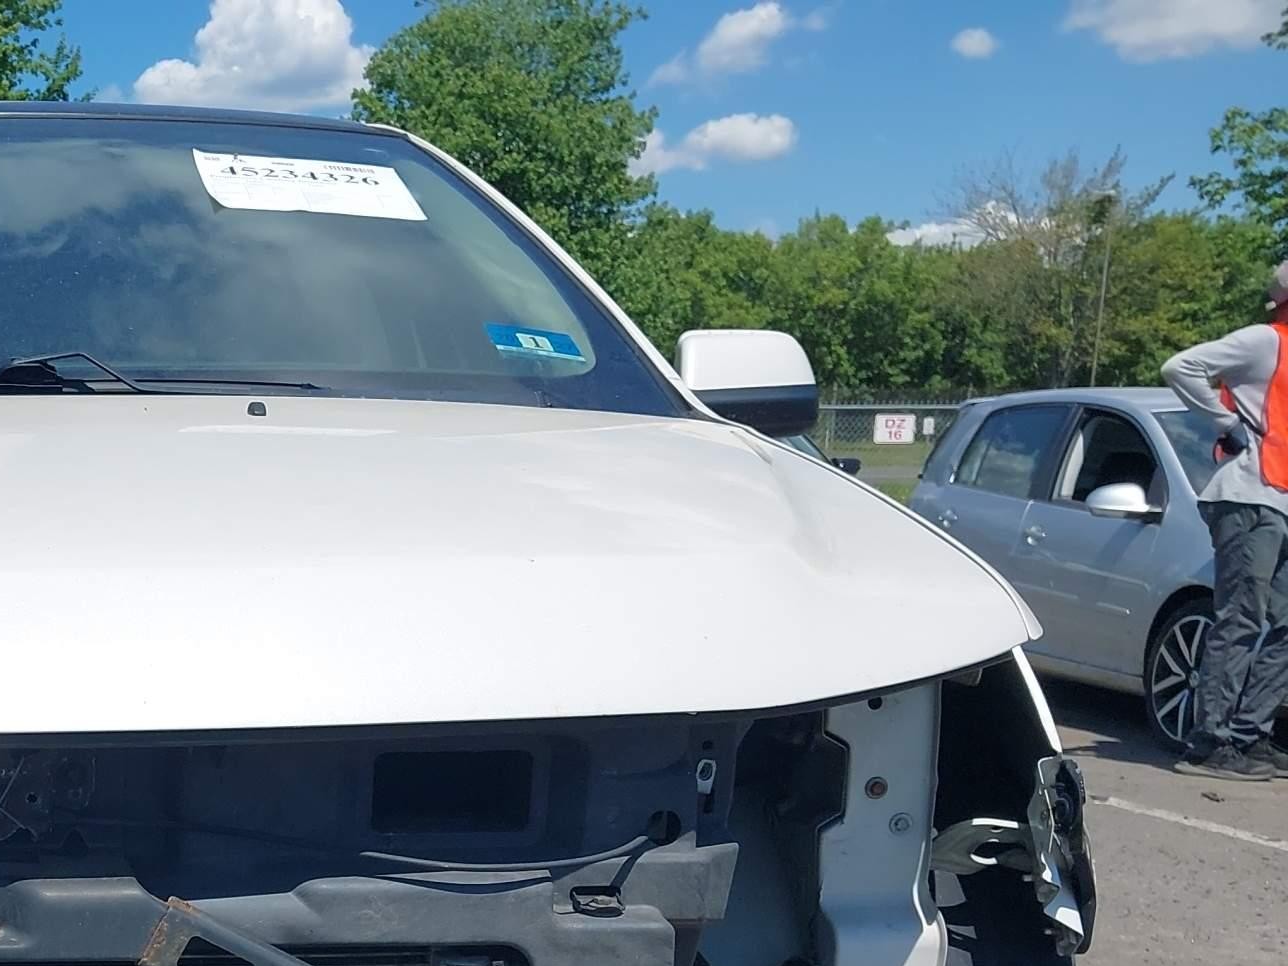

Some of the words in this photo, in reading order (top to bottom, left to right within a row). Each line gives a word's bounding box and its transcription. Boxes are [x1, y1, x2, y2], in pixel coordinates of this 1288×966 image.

[220, 166, 380, 186] 45234326
[884, 418, 906, 430] DZ
[887, 430, 903, 441] 16
